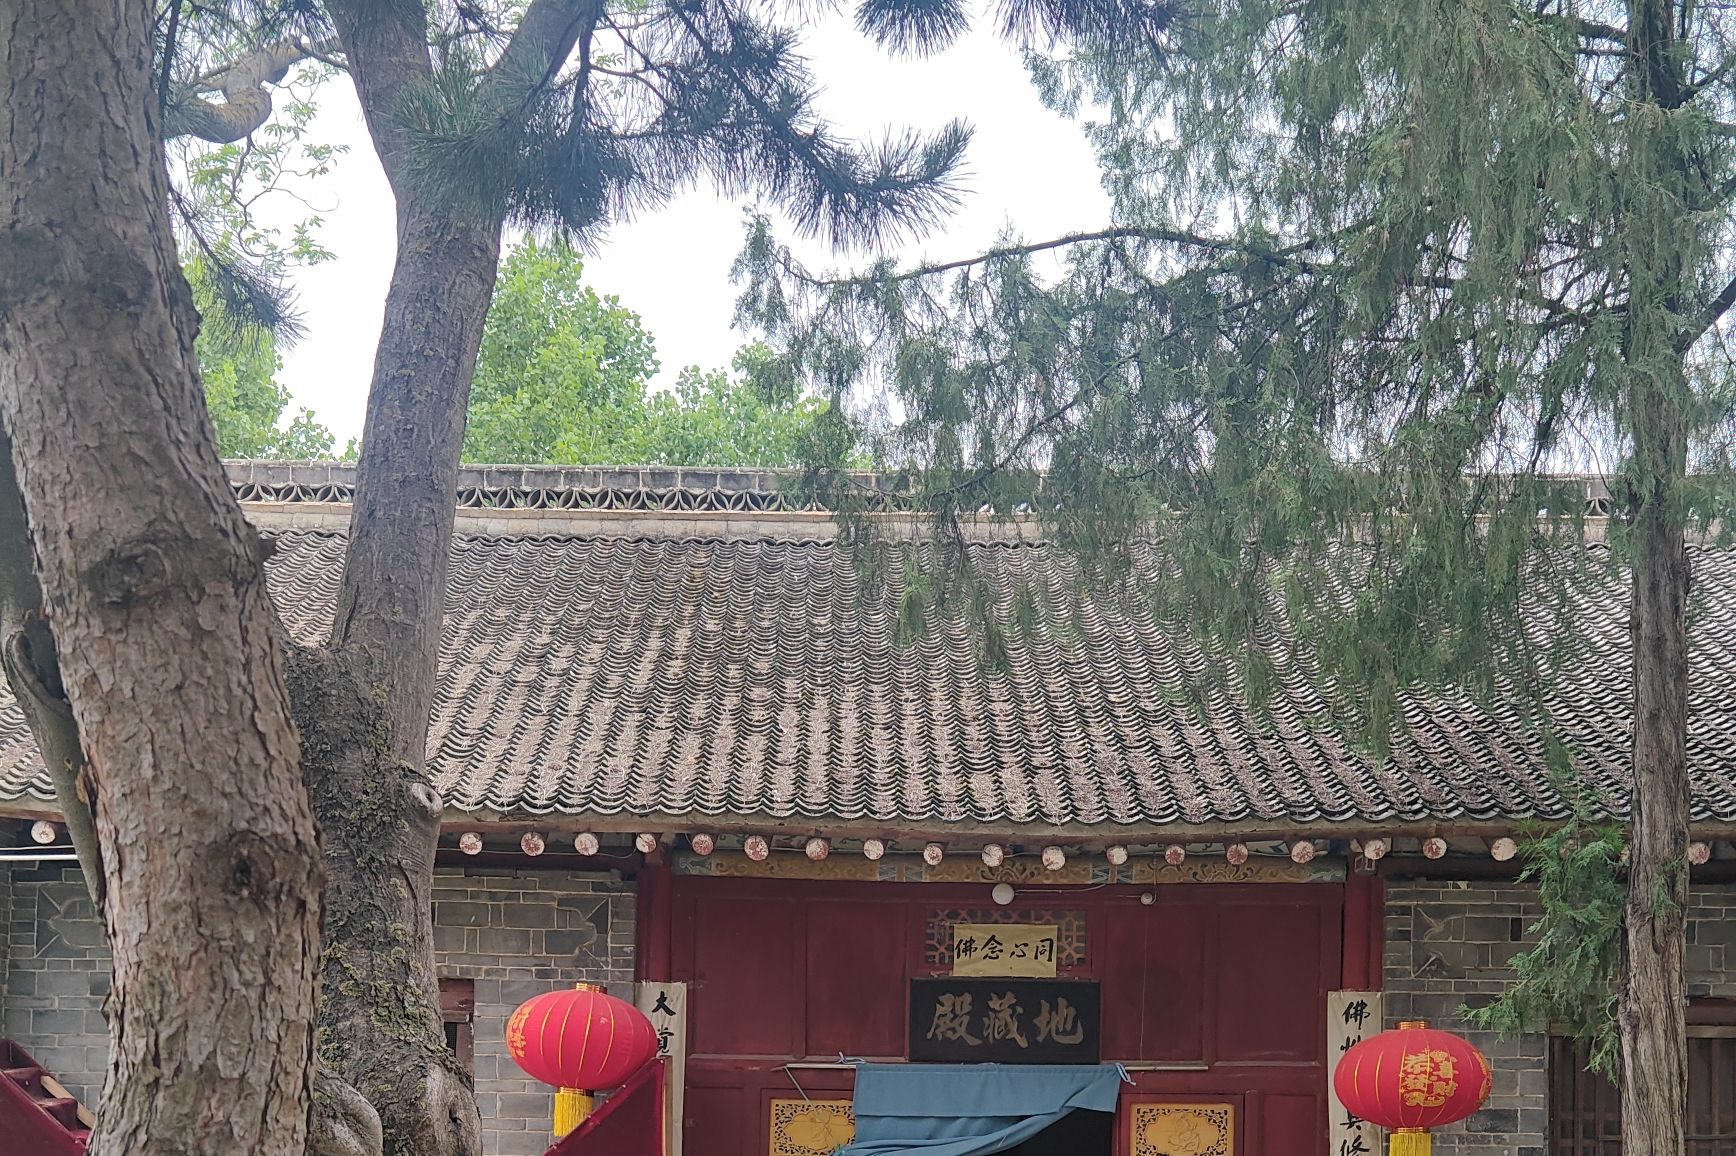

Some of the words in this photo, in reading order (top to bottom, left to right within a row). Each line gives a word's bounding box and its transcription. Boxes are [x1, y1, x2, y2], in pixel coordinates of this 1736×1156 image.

[955, 934, 1054, 962] 同心念佛
[926, 992, 1083, 1048] 地藏殿
